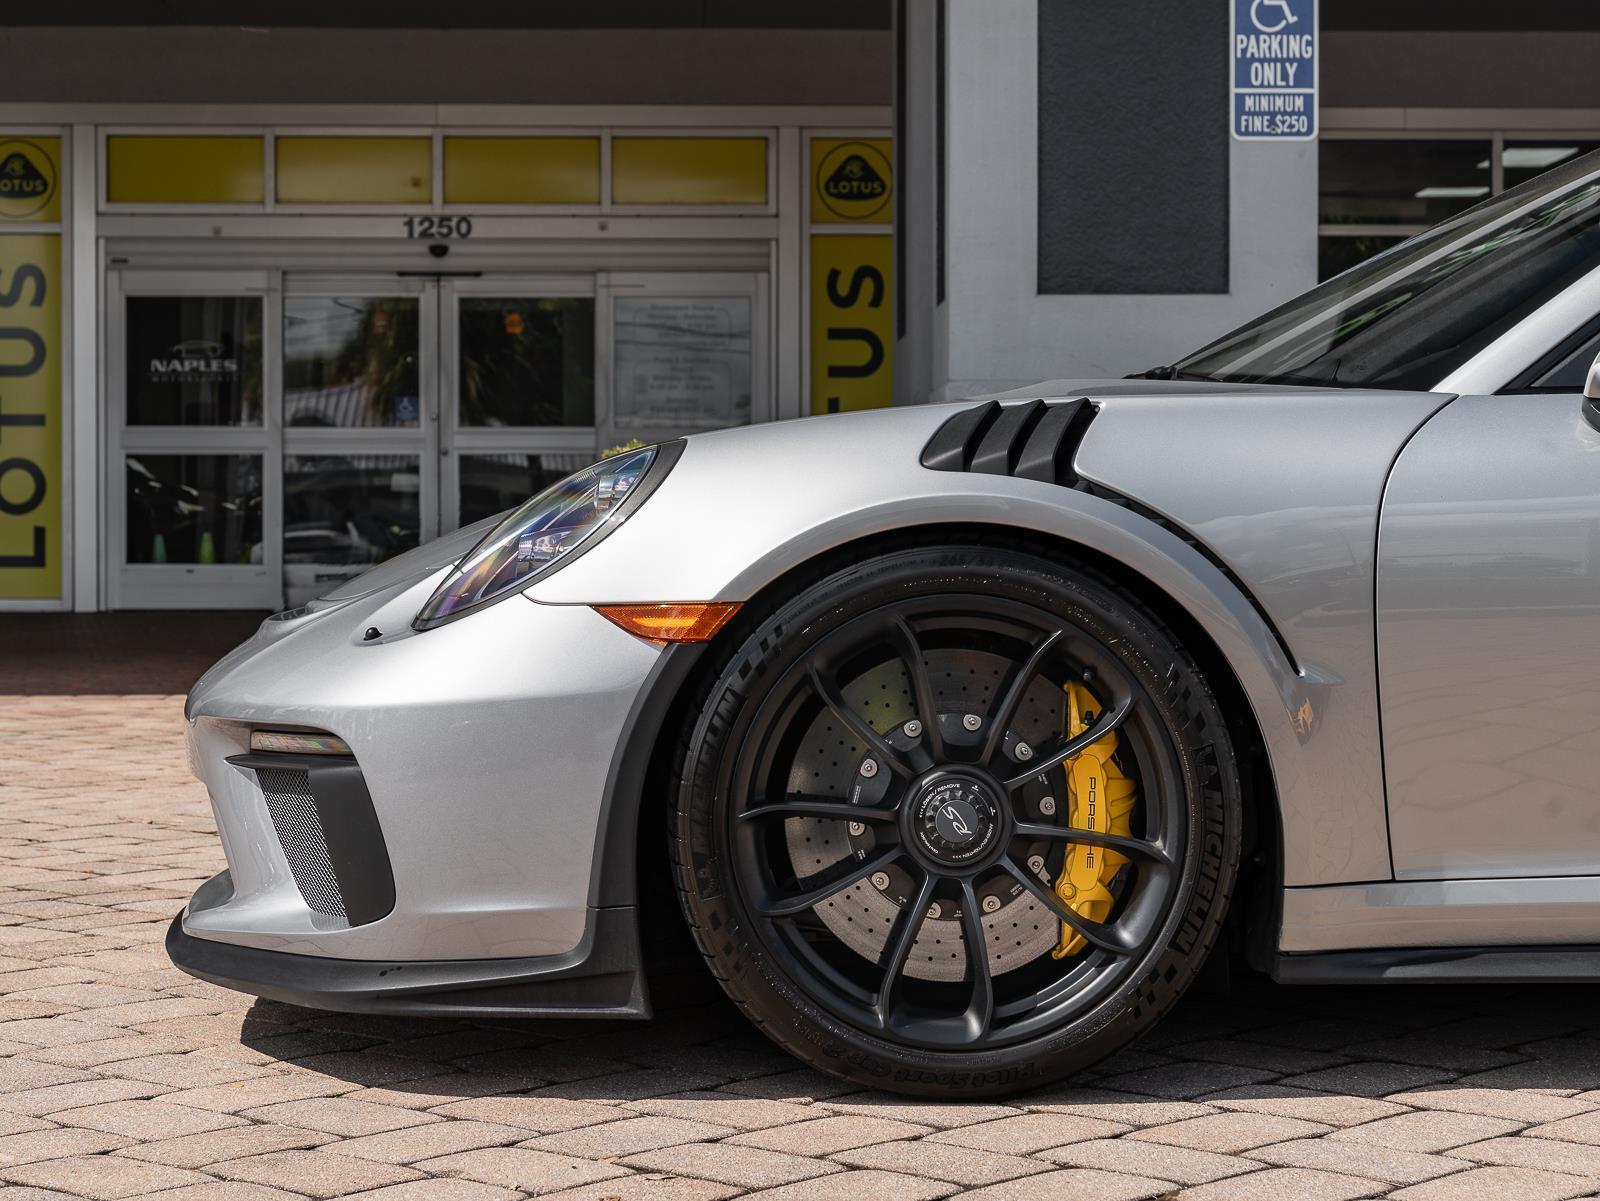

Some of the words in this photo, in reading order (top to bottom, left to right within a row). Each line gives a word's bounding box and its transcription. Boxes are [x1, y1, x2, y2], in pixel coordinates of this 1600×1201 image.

[1236, 34, 1313, 59] PARKING
[1250, 62, 1298, 87] ONLY
[1244, 95, 1304, 112] MINIMUM
[1241, 115, 1270, 132] FINE
[1275, 114, 1308, 134] $250
[0, 180, 44, 192] OTUS
[829, 181, 883, 194] LOTUS
[403, 216, 472, 239] 1250
[150, 359, 238, 372] NAPLES
[1086, 776, 1097, 869] PORSHE
[1175, 790, 1224, 956] MICHELIN
